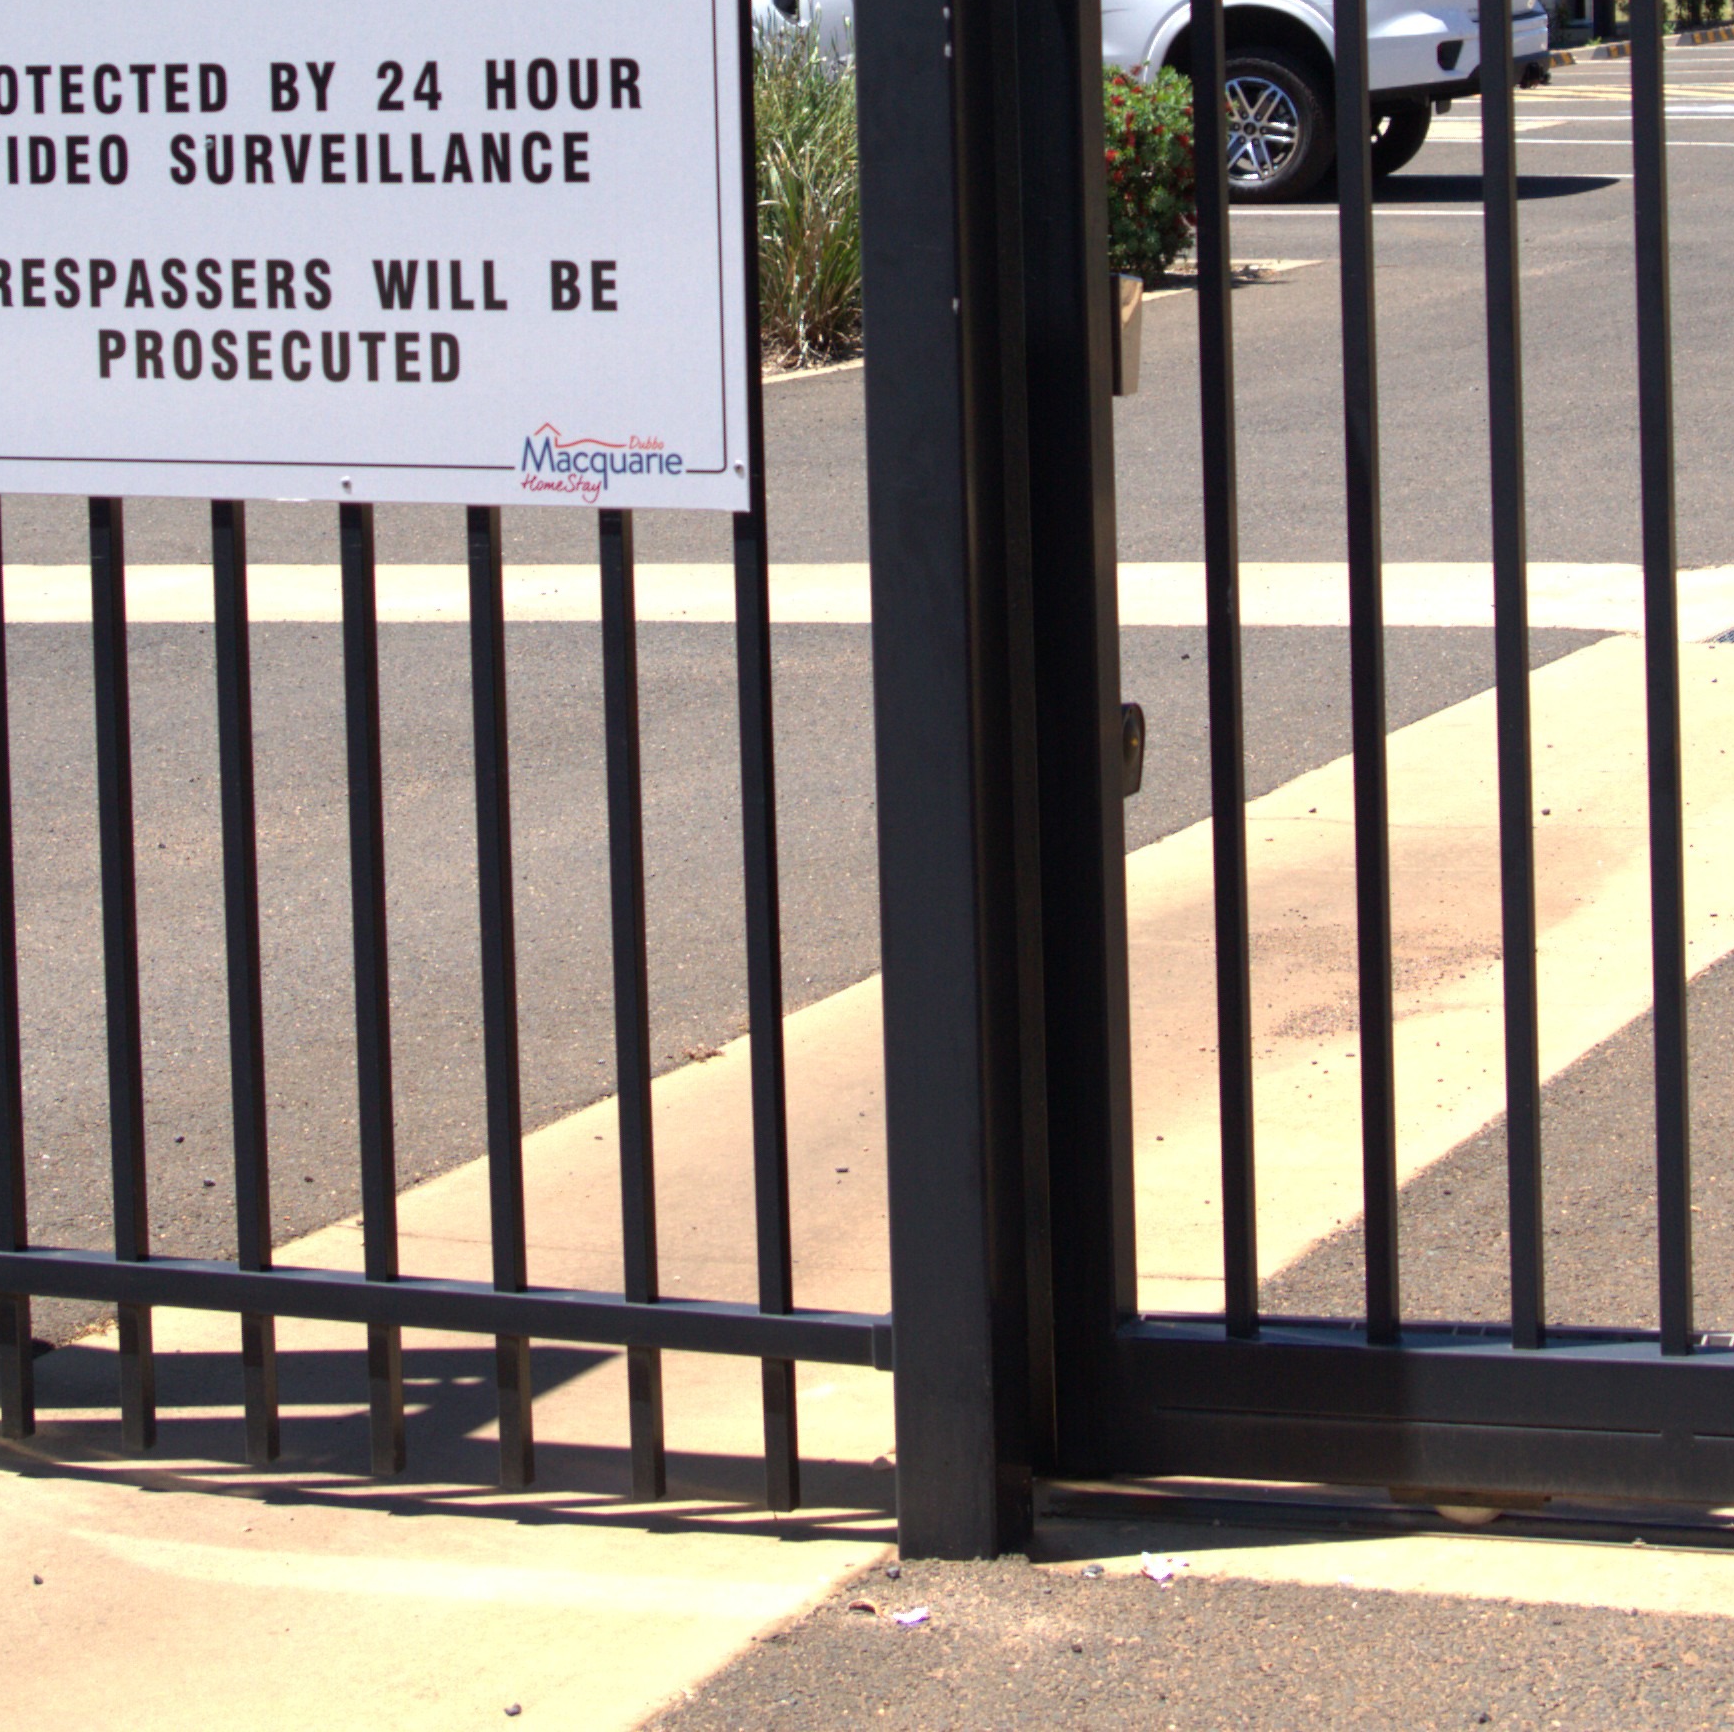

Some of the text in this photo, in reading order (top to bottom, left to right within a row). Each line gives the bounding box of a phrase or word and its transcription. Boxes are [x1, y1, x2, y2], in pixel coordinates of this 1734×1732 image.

[270, 61, 335, 112] BY
[377, 60, 442, 111] 24
[485, 57, 641, 111] HOUR
[170, 131, 590, 185] SURVEILLANCE
[372, 259, 508, 311] WILL
[550, 260, 618, 311] BE
[98, 329, 460, 383] PROSECUTED
[521, 436, 683, 491] Macquarie
[628, 435, 665, 451] Dubbo
